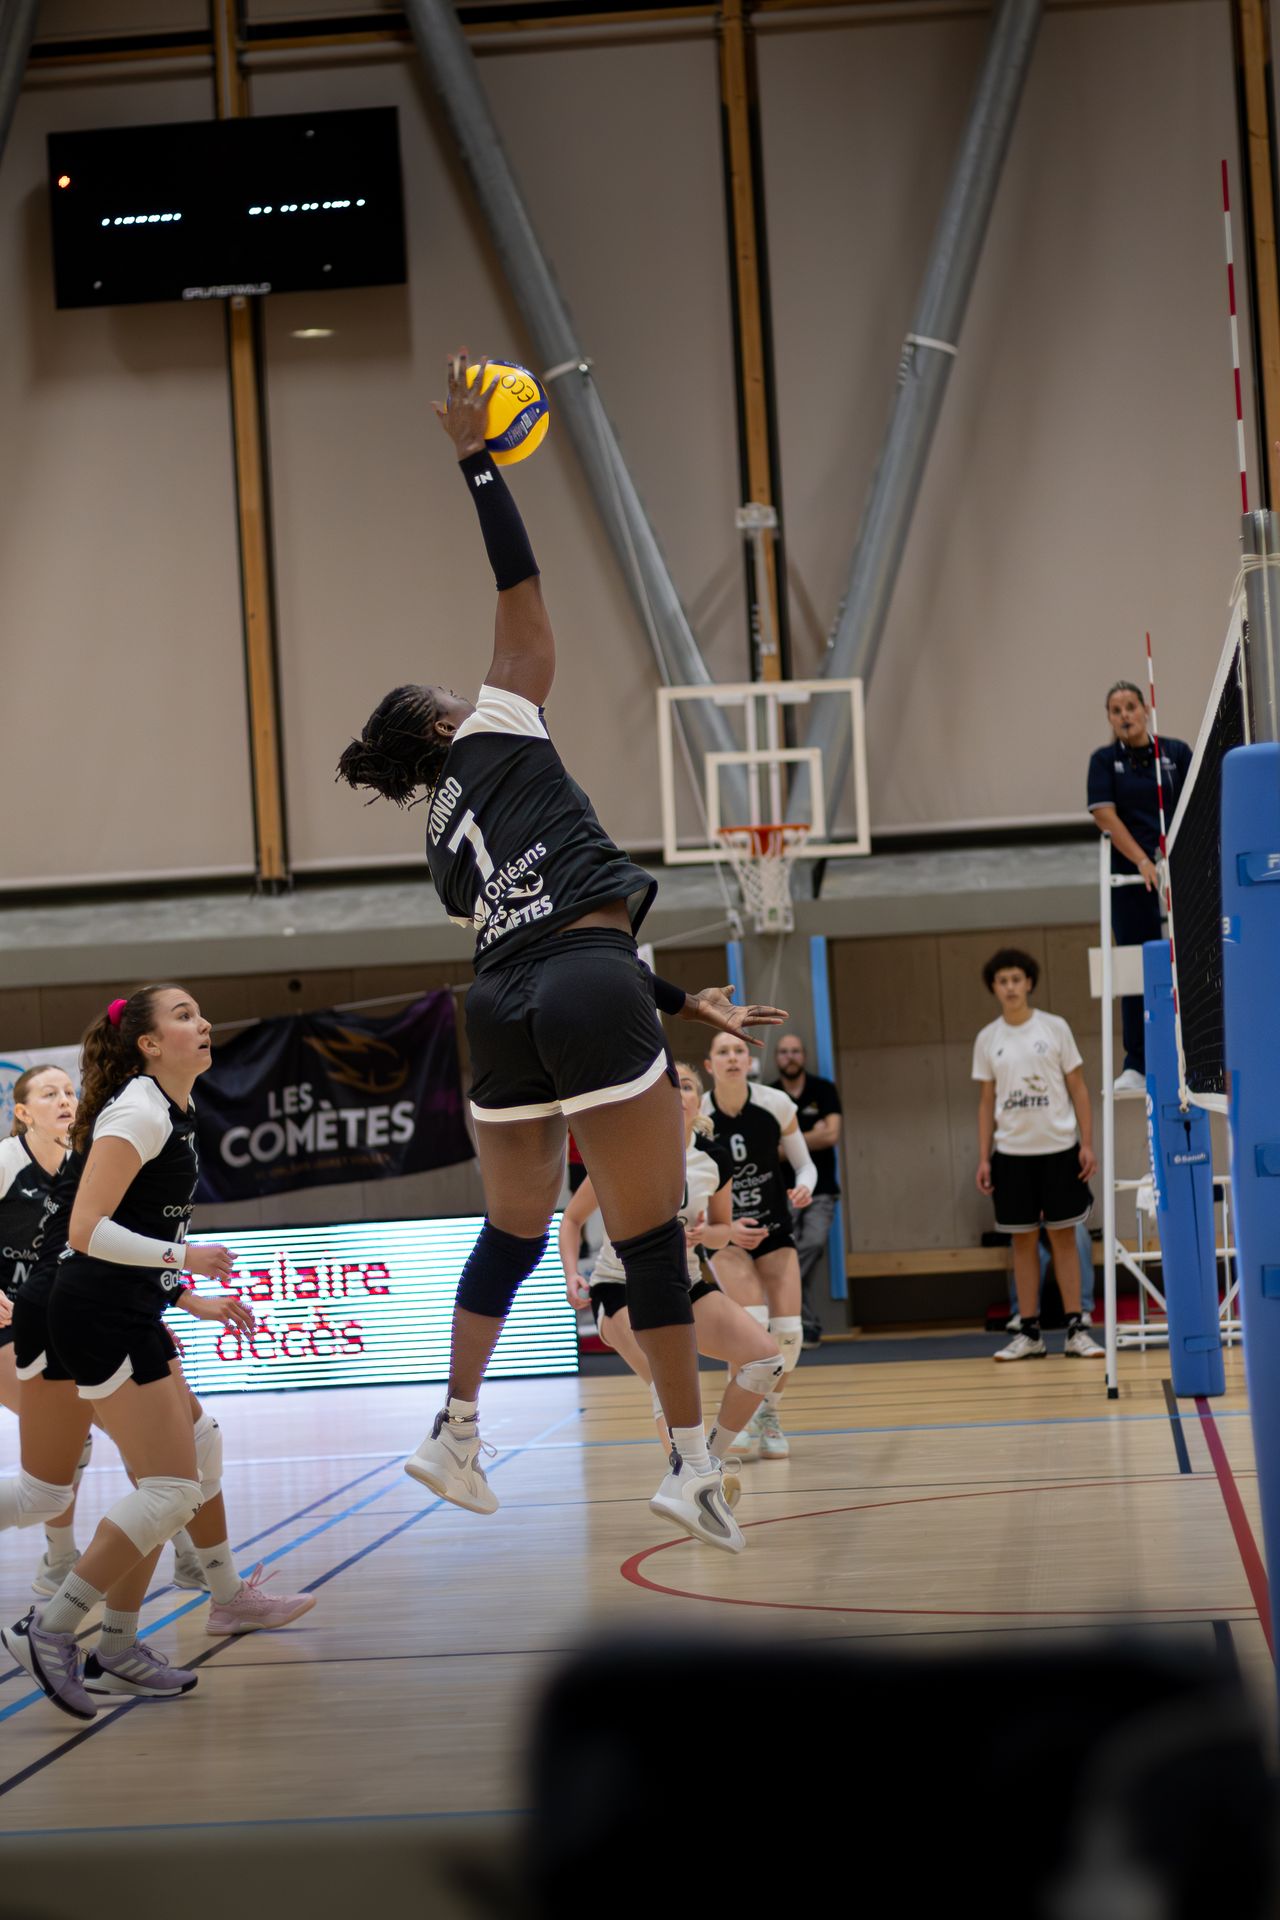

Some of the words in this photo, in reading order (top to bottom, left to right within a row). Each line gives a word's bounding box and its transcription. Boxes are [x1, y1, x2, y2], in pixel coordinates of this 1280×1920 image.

[427, 776, 463, 846] ZONGO
[447, 808, 495, 883] 7
[485, 841, 547, 900] Orléans
[267, 1082, 314, 1119] LES
[219, 1099, 415, 1168] COMÈTES
[730, 1133, 748, 1163] 6
